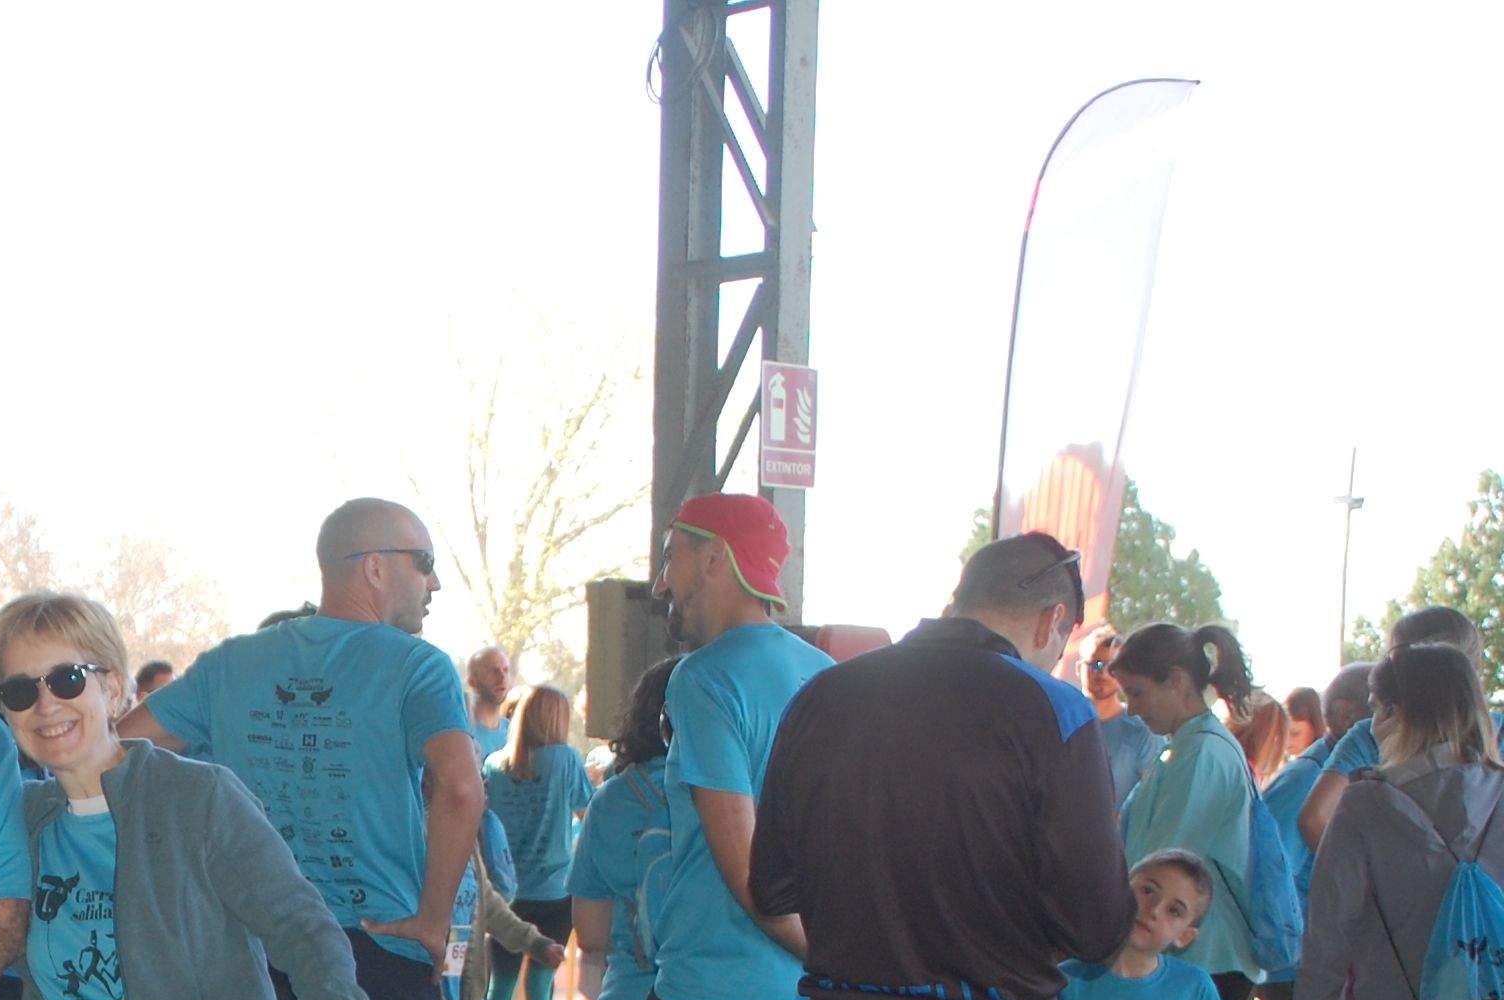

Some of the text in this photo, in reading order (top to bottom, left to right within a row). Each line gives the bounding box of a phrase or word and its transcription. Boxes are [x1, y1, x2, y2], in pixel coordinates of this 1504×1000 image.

[765, 460, 811, 475] EXTINTOR
[69, 903, 113, 920] solida
[452, 944, 466, 960] 69
